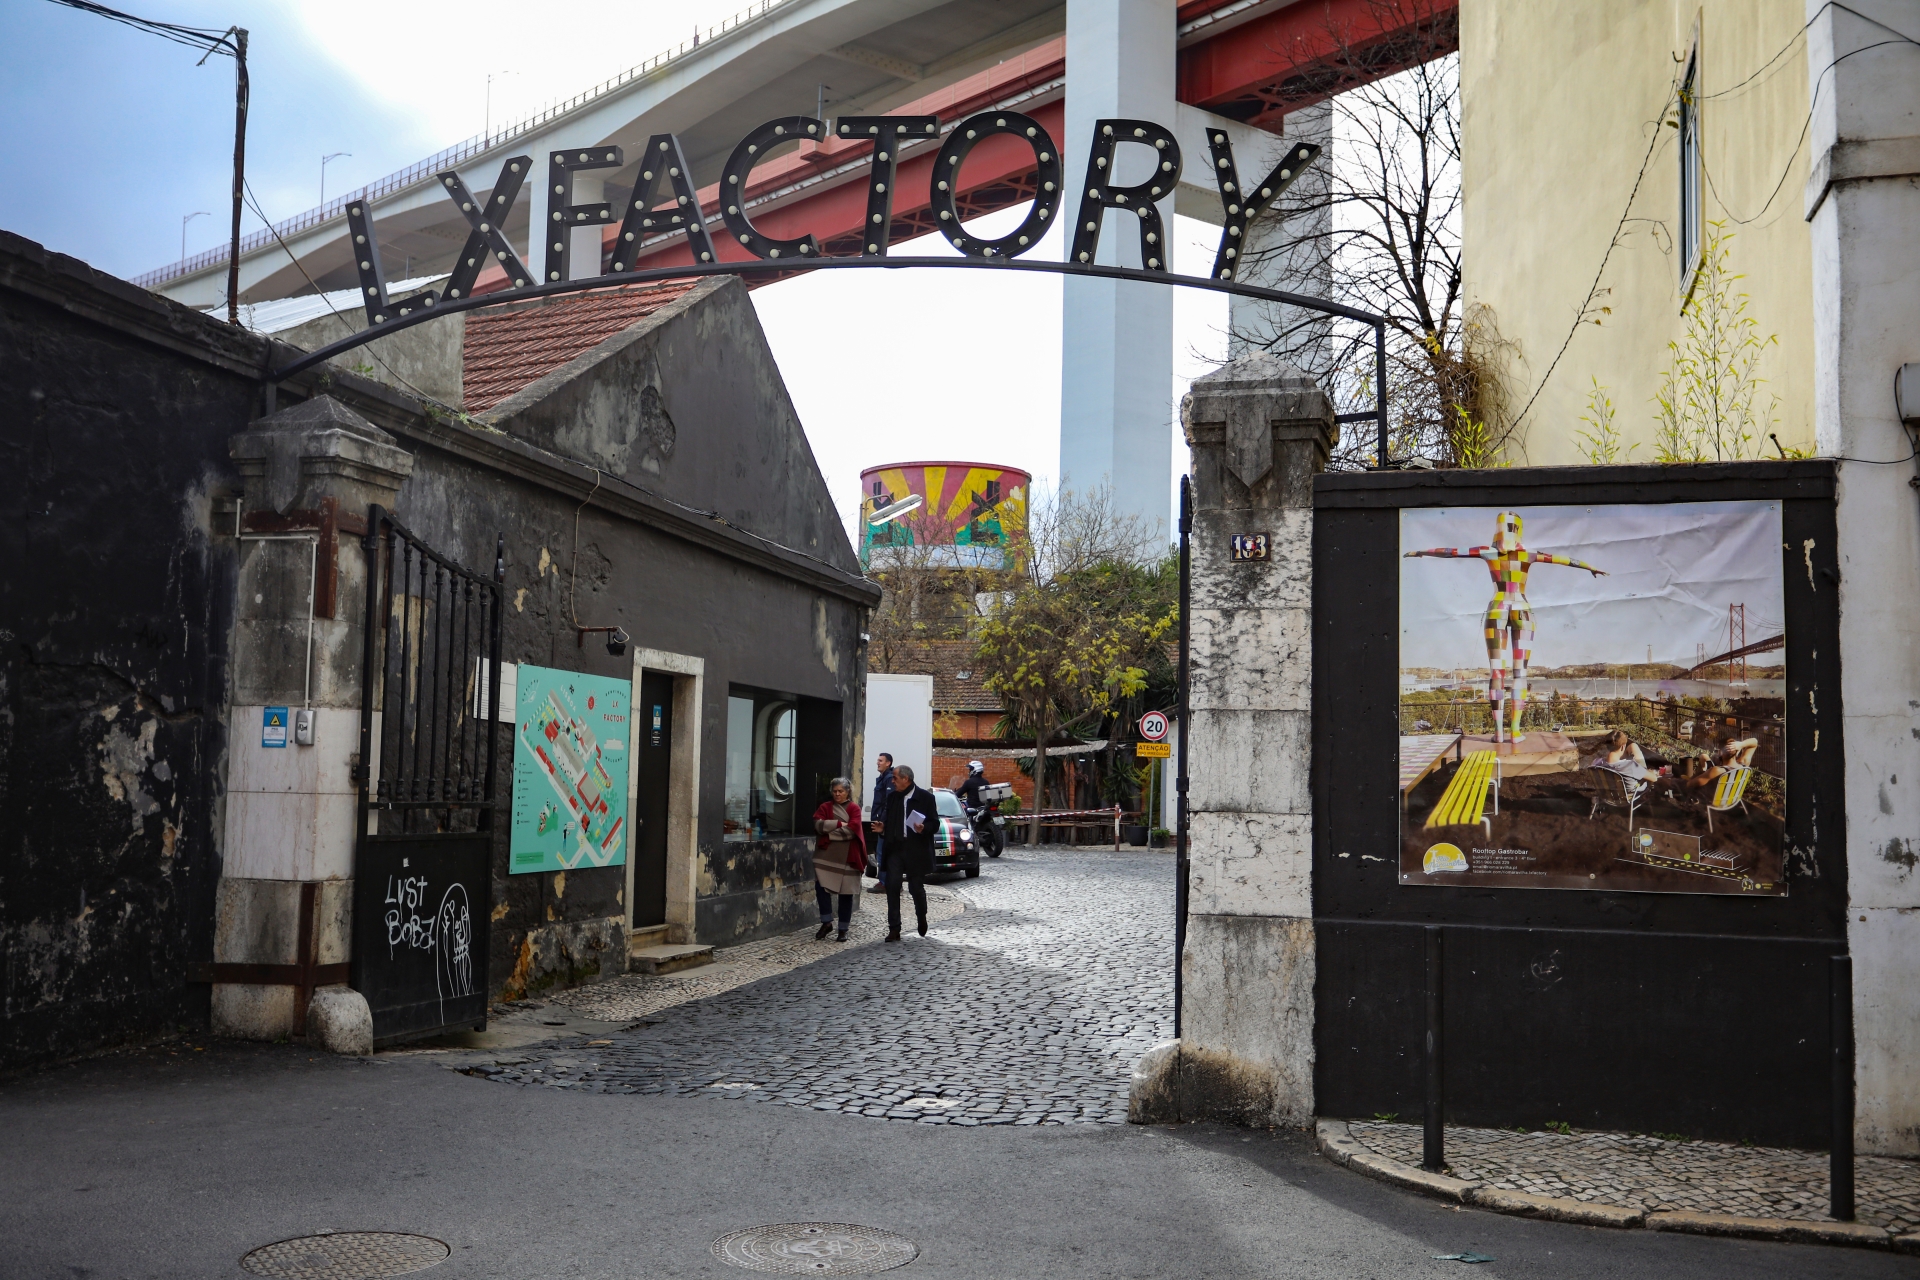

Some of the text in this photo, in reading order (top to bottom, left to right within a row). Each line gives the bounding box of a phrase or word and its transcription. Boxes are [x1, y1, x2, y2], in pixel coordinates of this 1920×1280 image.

[603, 713, 626, 722] FACTORY
[1146, 720, 1163, 732] 20
[1472, 847, 1496, 856] Rooftop
